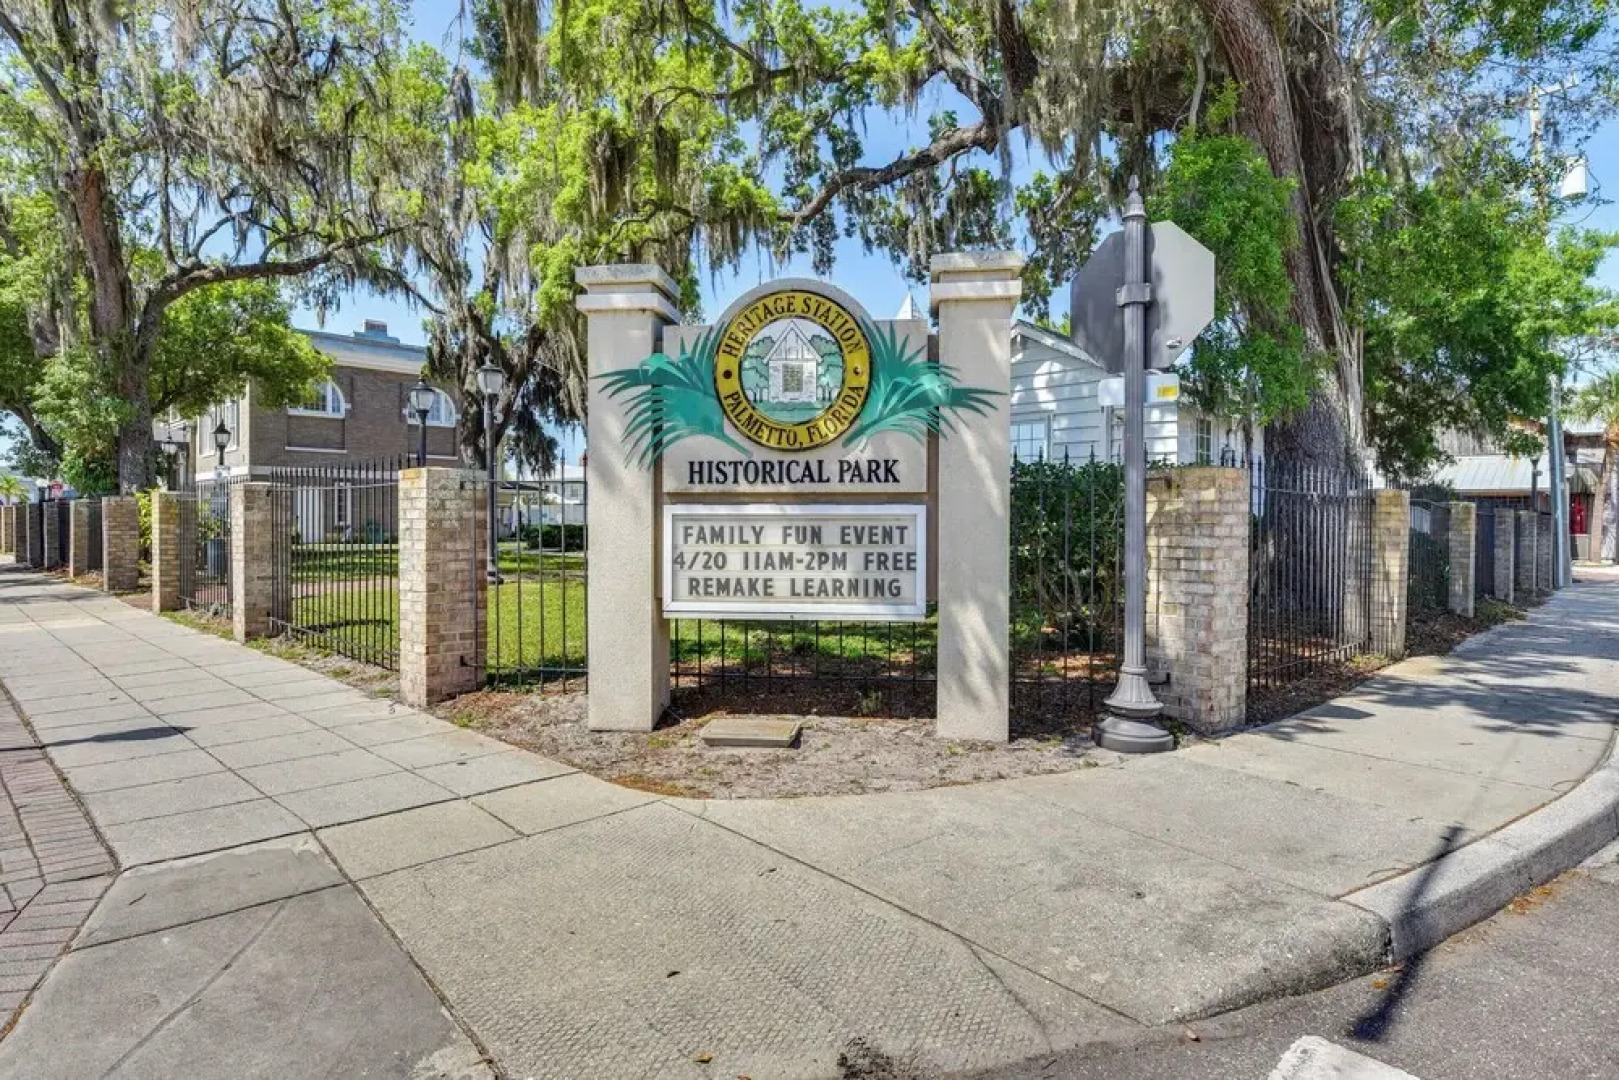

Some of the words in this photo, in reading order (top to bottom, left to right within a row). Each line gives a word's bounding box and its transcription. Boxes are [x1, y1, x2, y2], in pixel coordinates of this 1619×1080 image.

[722, 296, 795, 358] HERITAGE
[801, 296, 863, 354] STATION
[724, 391, 803, 447] PALMETTO,
[806, 386, 865, 442] FLORIDA
[688, 460, 830, 484] HISTORICAL
[838, 460, 900, 483] PARK
[683, 526, 764, 544] FAMILY
[782, 526, 822, 544] FUN
[840, 526, 908, 544] EVENT
[672, 552, 727, 570] 4/20
[743, 552, 847, 570] 11AM-2PM
[864, 552, 916, 570] FREE
[688, 578, 774, 596] REMAKE
[790, 578, 901, 597] LEARNING
